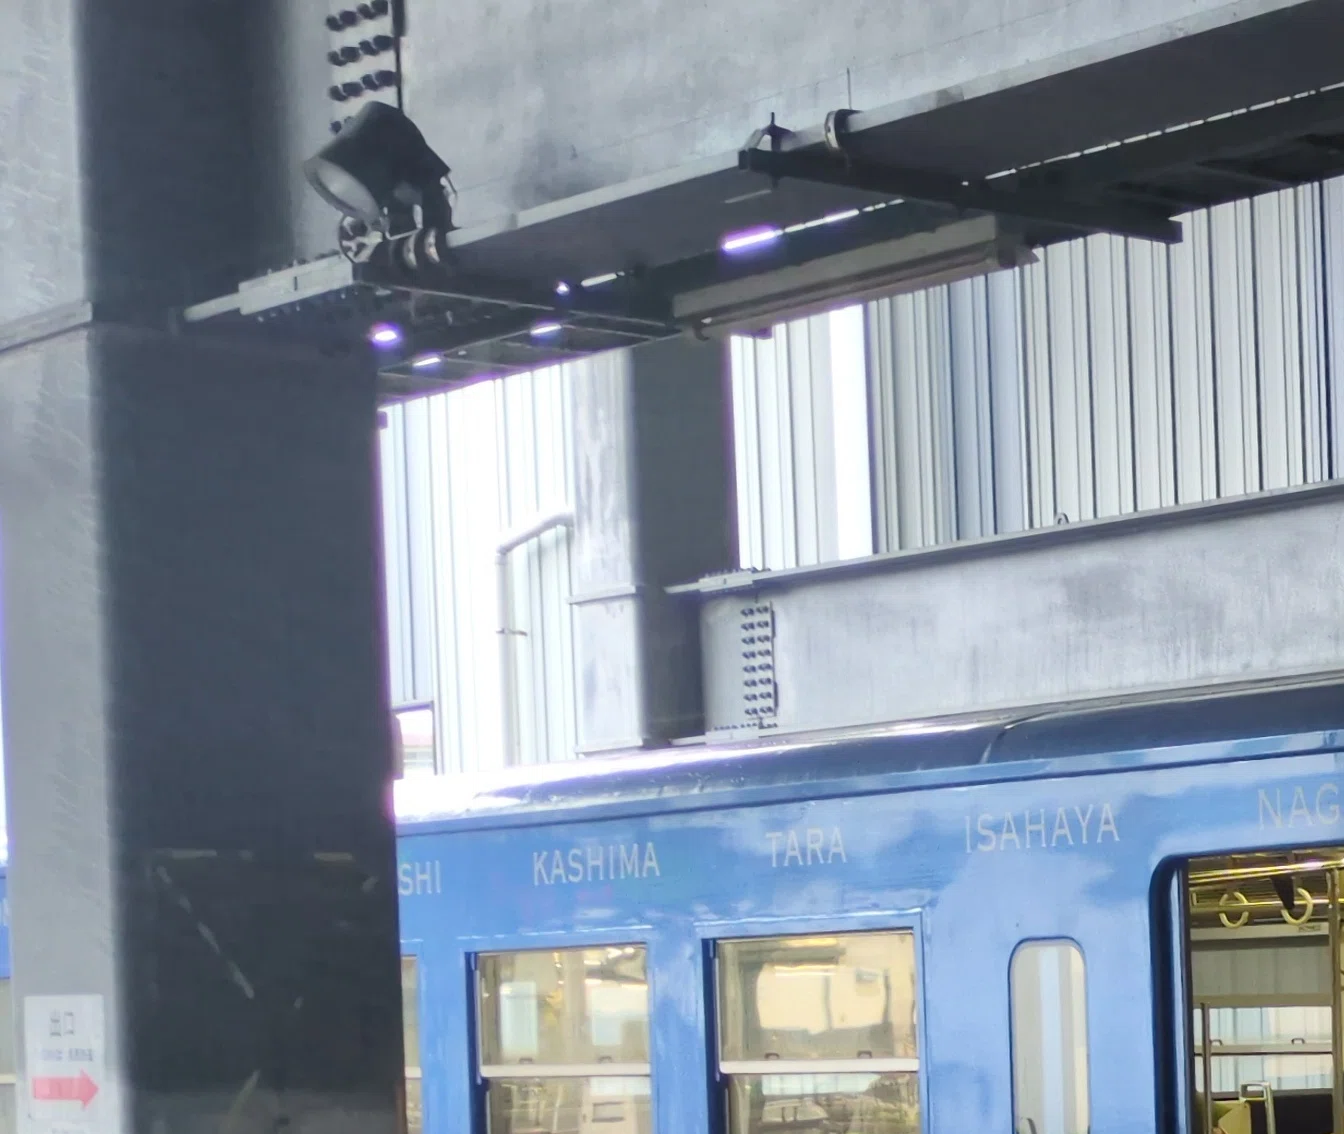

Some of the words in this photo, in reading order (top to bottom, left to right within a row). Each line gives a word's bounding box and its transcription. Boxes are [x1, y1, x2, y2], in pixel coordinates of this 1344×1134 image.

[765, 826, 848, 868] TARA
[965, 801, 1121, 855] ISAHAYA
[398, 860, 441, 896] SHI
[532, 841, 661, 886] KASHIMA
